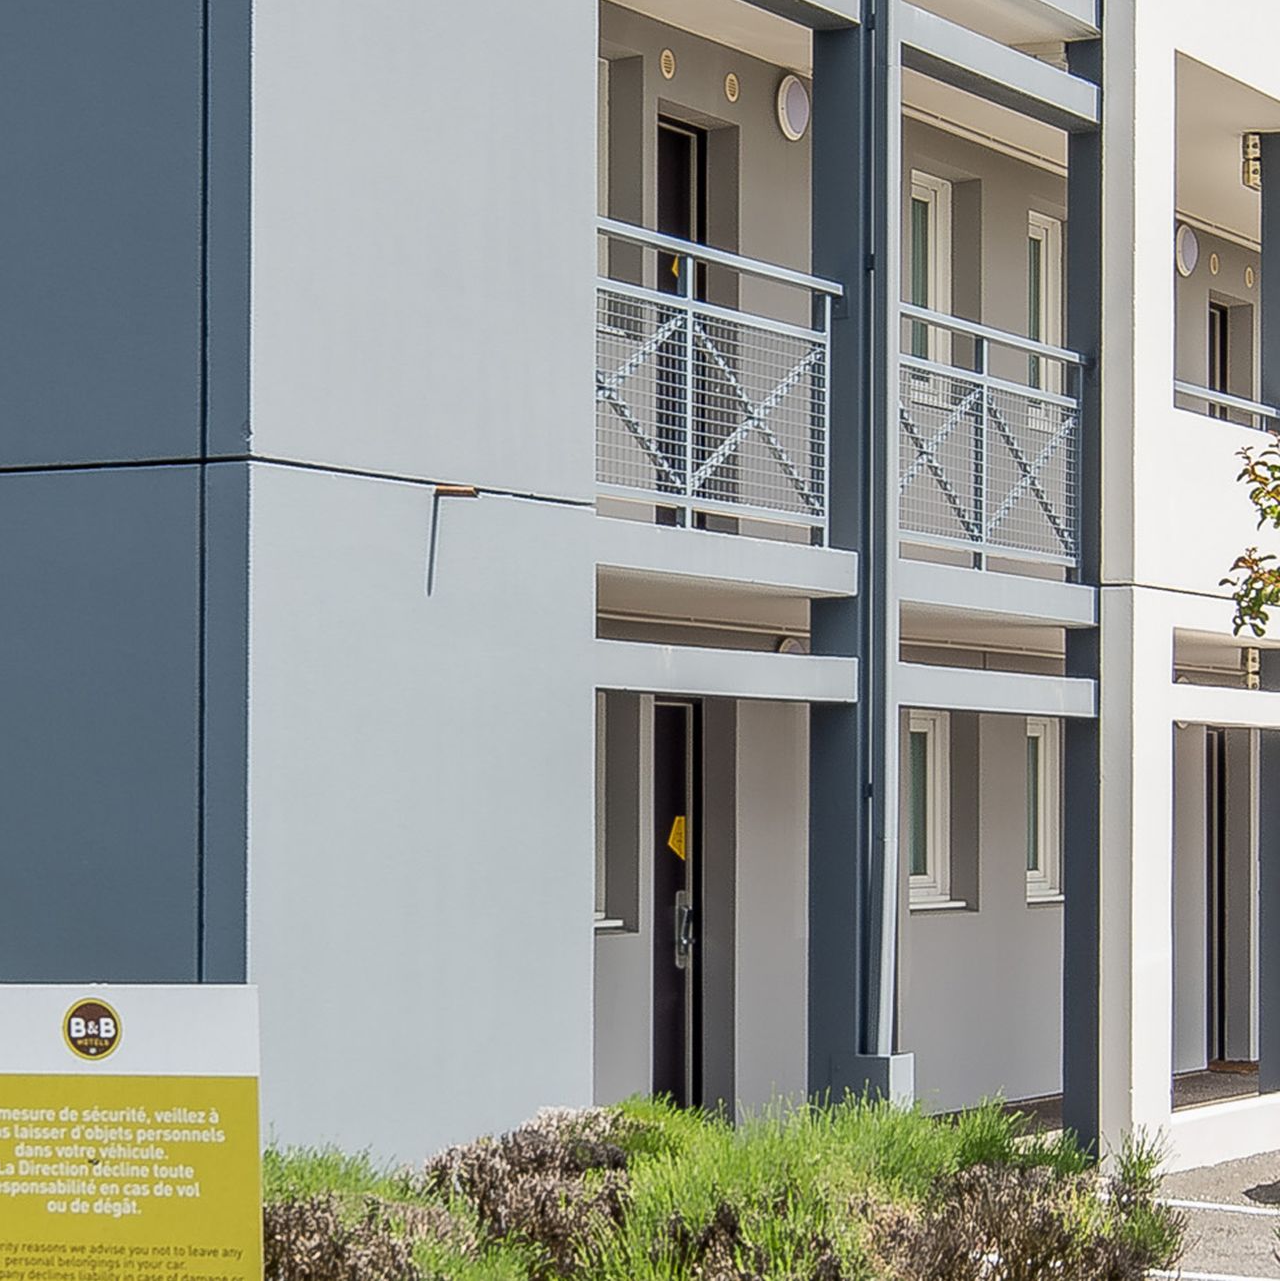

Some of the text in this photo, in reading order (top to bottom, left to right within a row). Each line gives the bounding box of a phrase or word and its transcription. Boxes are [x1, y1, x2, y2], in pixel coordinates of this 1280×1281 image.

[70, 1017, 116, 1038] B&B
[59, 1105, 79, 1122] de
[82, 1105, 151, 1125] sécurité,
[154, 1106, 206, 1123] veillez
[208, 1106, 220, 1124] à
[13, 1124, 67, 1139] laisser
[70, 1125, 133, 1144] d'objets
[136, 1127, 226, 1144] personnels
[14, 1142, 169, 1160] dans votre véhicule.
[18, 1160, 89, 1176] Direction
[92, 1161, 150, 1178] décline
[152, 1164, 195, 1179] toute
[99, 1182, 120, 1196] en
[123, 1182, 150, 1196] cas
[153, 1181, 173, 1197] de
[176, 1181, 200, 1197] vol
[47, 1197, 142, 1218] ou de dégât.
[21, 1242, 67, 1254] reasons
[70, 1244, 86, 1254] we
[88, 1243, 126, 1256] advise
[128, 1245, 150, 1258] you
[151, 1246, 171, 1257] not
[173, 1246, 186, 1257] to
[188, 1245, 219, 1258] leave
[221, 1248, 244, 1261] any
[4, 1255, 55, 1268] personal
[57, 1255, 121, 1271] belongings
[123, 1258, 135, 1269] in
[137, 1260, 163, 1272] your
[28, 1269, 75, 1281] declines
